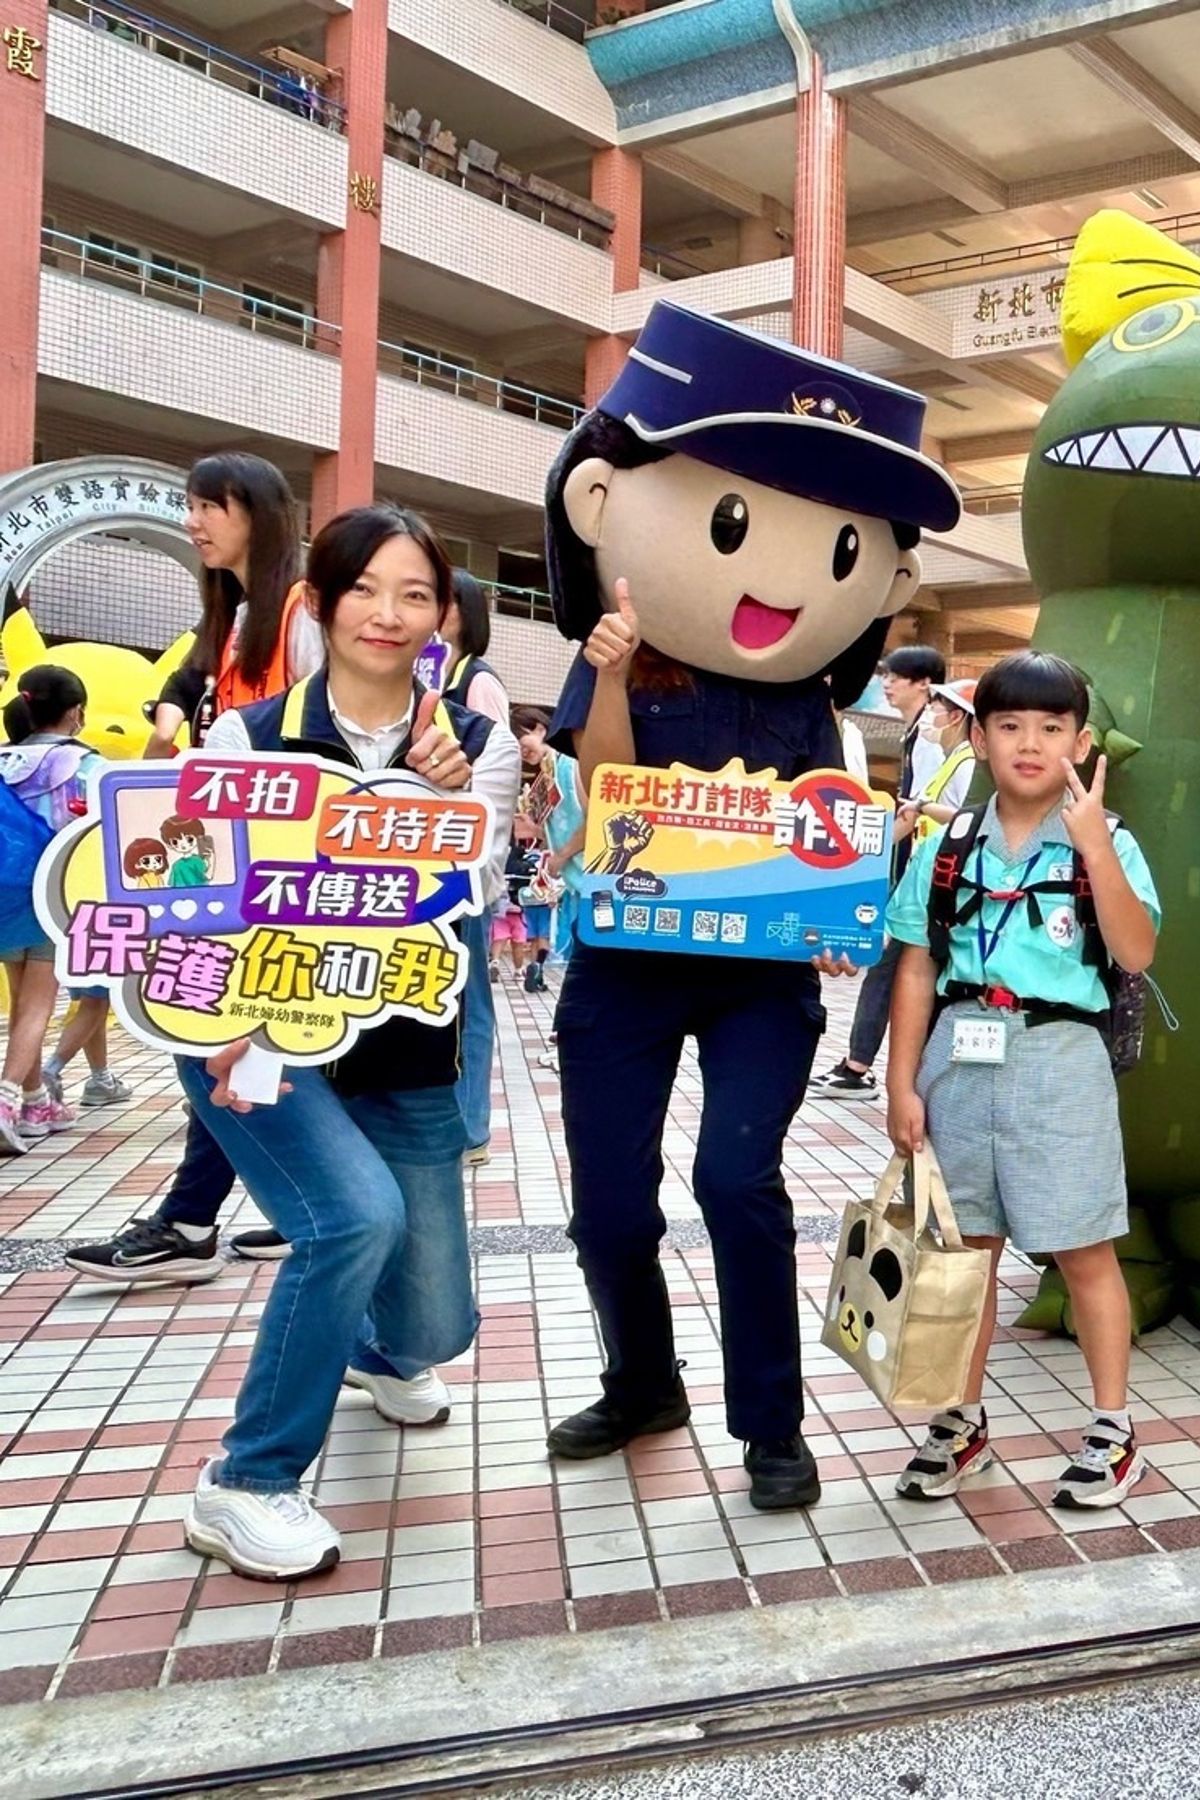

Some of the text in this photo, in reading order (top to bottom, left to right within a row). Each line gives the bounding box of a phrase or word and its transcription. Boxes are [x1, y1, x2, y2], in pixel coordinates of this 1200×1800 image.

[2, 25, 42, 82] 霞
[973, 276, 1066, 323] 新北市
[3, 542, 25, 563] New
[36, 511, 75, 533] Taipei
[92, 502, 118, 512] City
[190, 766, 301, 818] 不拍
[599, 770, 774, 818] 新北打詐隊
[322, 802, 482, 854] 不持有
[772, 790, 889, 856] 詐騙
[248, 869, 412, 920] 不傳送
[67, 901, 458, 1016] 保護你和我
[229, 1003, 336, 1028] 新北婦幼警察隊
